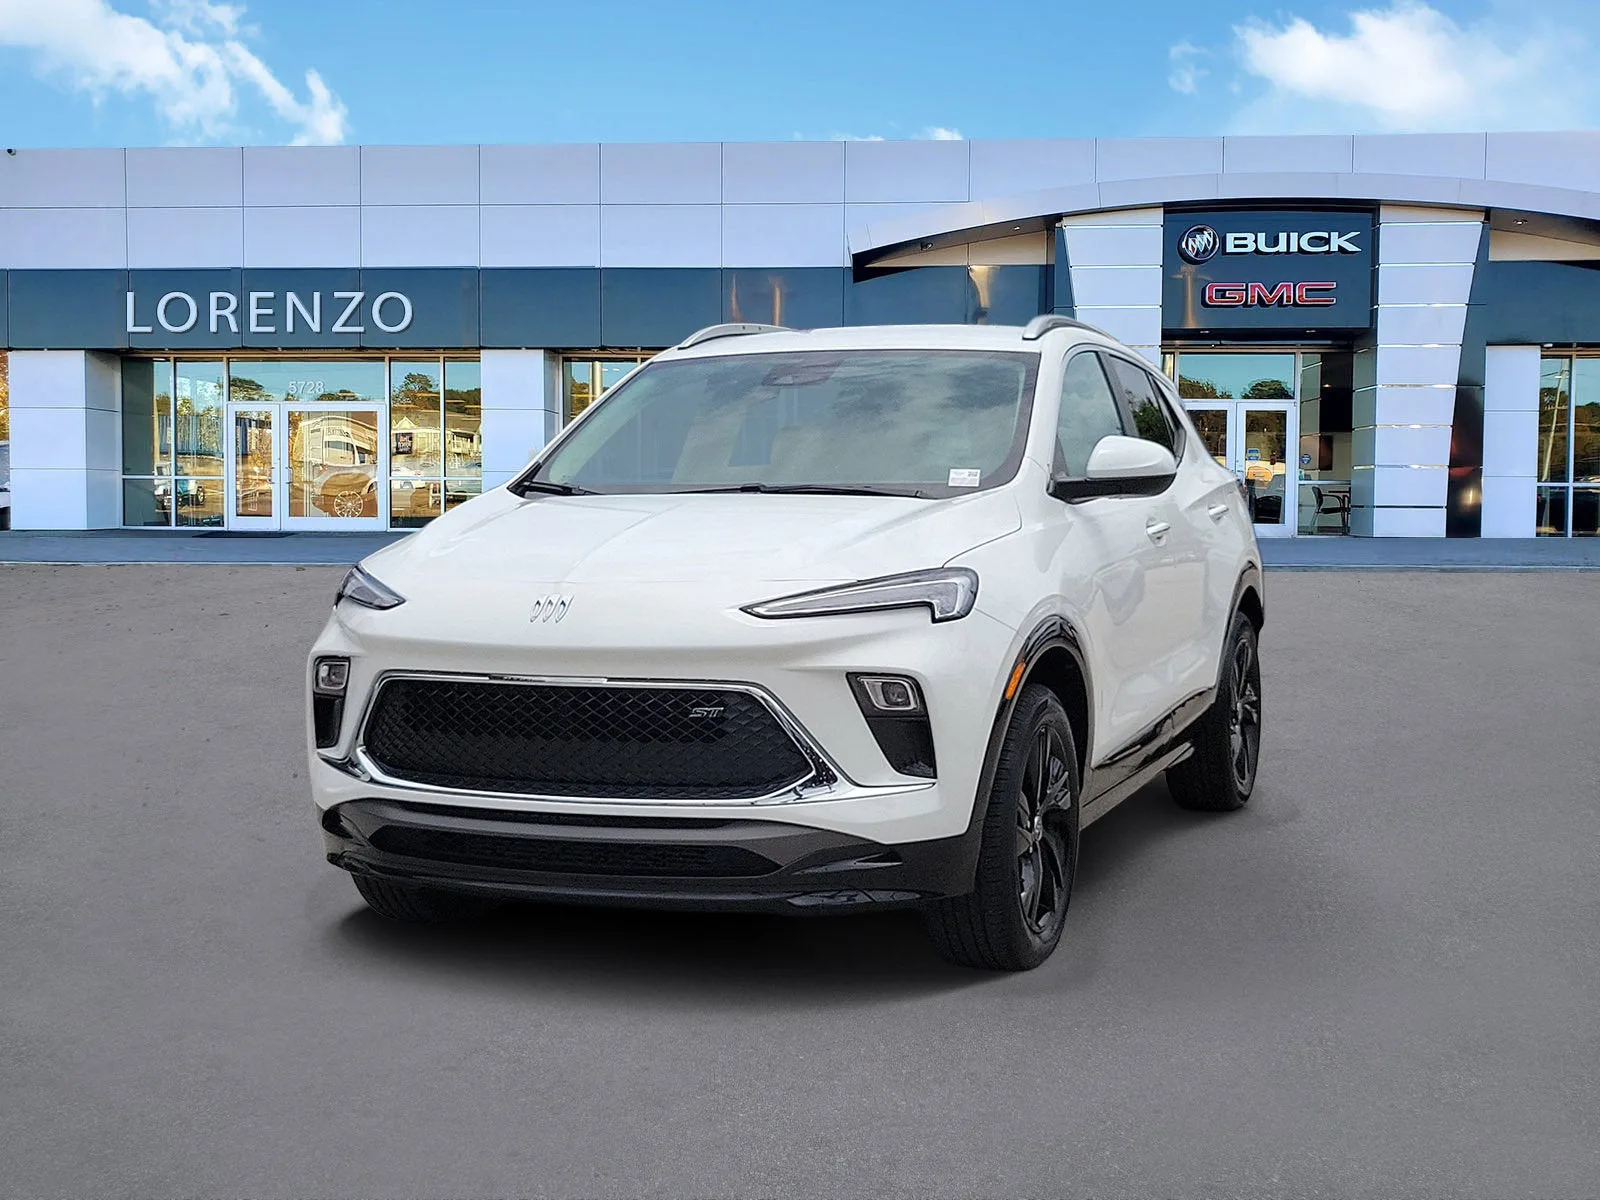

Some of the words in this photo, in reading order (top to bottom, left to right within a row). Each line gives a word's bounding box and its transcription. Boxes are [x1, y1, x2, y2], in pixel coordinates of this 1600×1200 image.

[1225, 231, 1362, 253] BUICK
[1206, 282, 1337, 305] GMC
[126, 291, 413, 333] LORENZO
[288, 381, 325, 394] 5728
[689, 707, 724, 717] ST
